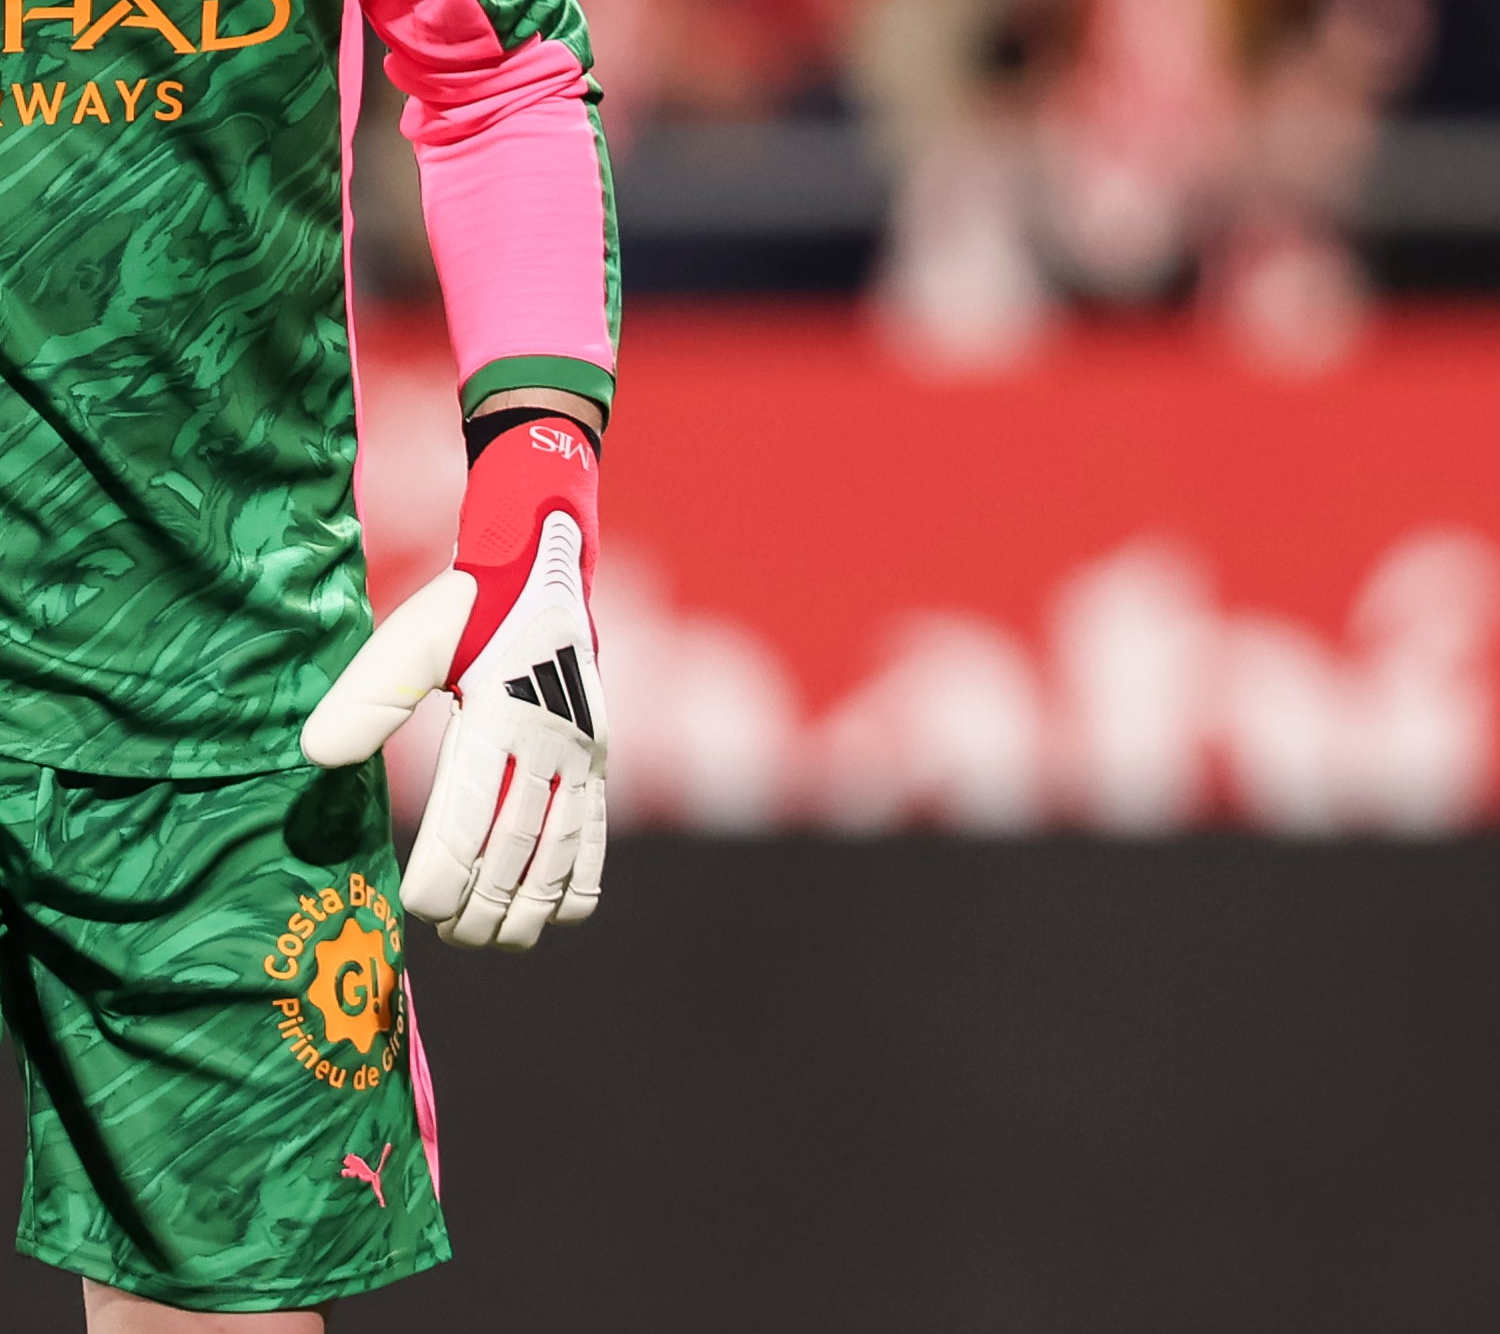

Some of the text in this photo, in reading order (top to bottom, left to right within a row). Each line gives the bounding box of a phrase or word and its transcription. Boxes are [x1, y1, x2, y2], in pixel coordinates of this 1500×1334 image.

[263, 872, 402, 981] Costa Brava
[272, 997, 347, 1089] Pirineu
[353, 1063, 381, 1090] de
